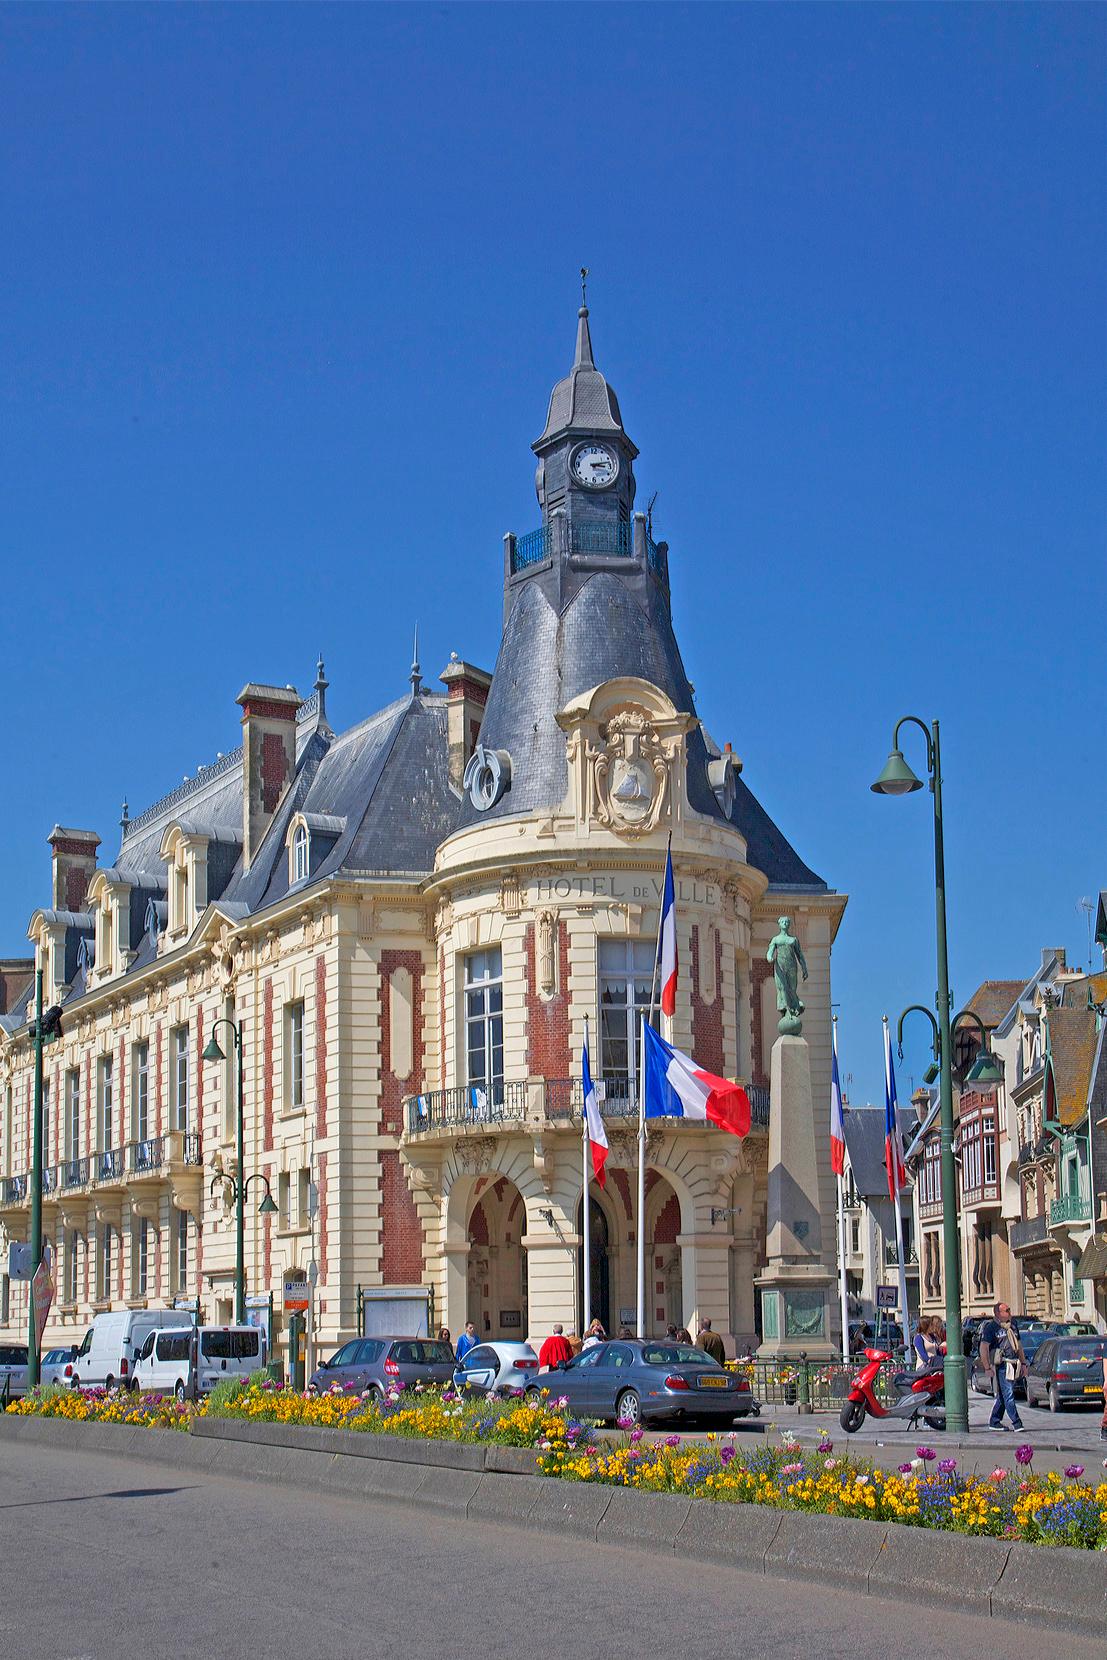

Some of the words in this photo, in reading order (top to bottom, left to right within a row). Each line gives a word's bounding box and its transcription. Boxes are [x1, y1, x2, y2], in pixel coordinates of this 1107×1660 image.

[536, 876, 626, 900] HOTEL
[633, 886, 649, 898] DE
[651, 877, 716, 905] VLLE
